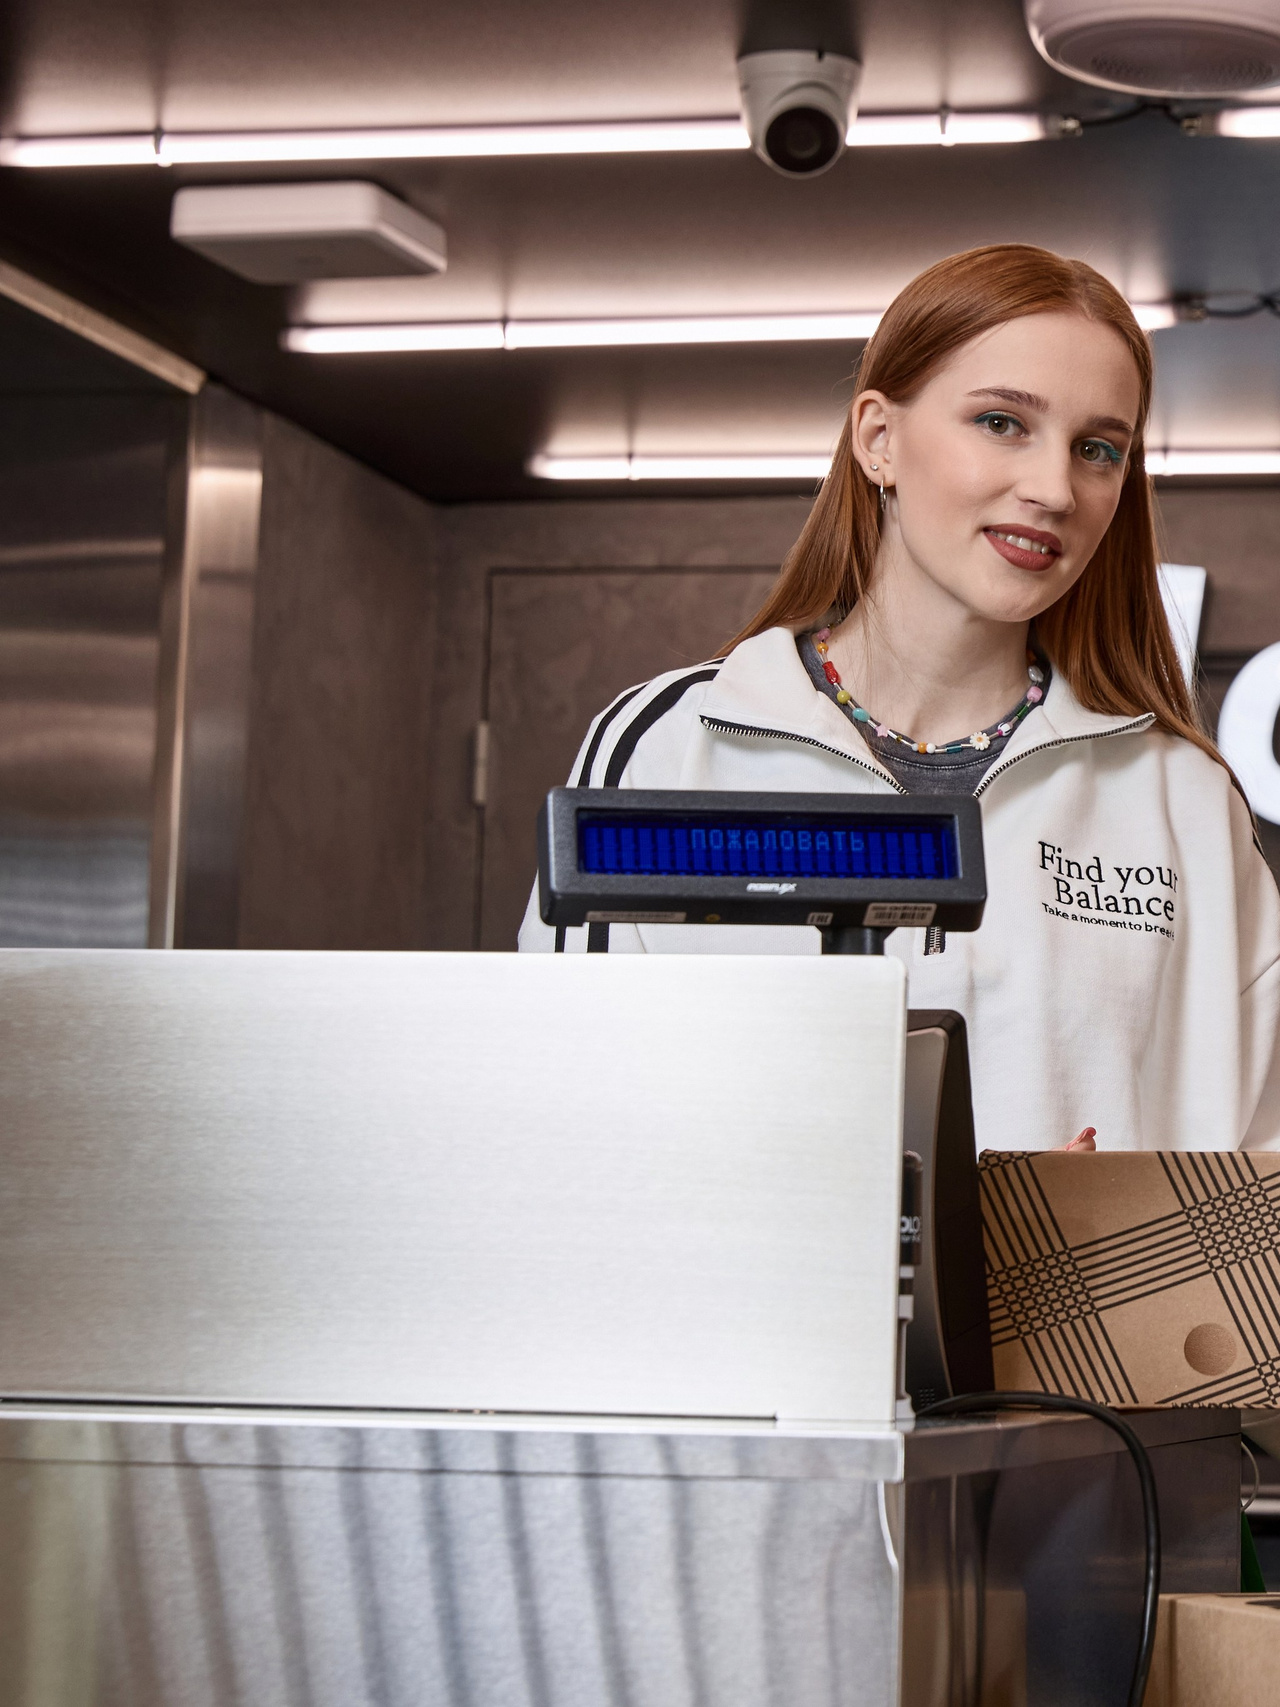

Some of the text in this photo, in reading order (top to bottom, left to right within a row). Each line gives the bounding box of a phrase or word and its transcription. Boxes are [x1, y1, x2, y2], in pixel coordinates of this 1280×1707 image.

[691, 829, 865, 851] ПОЖАЛОВАТЬ
[1038, 841, 1178, 894] Find your
[1042, 902, 1069, 920] Take
[1071, 913, 1079, 922] a
[1081, 916, 1127, 929] moment
[1129, 921, 1142, 931] to
[1053, 876, 1174, 922] Balance
